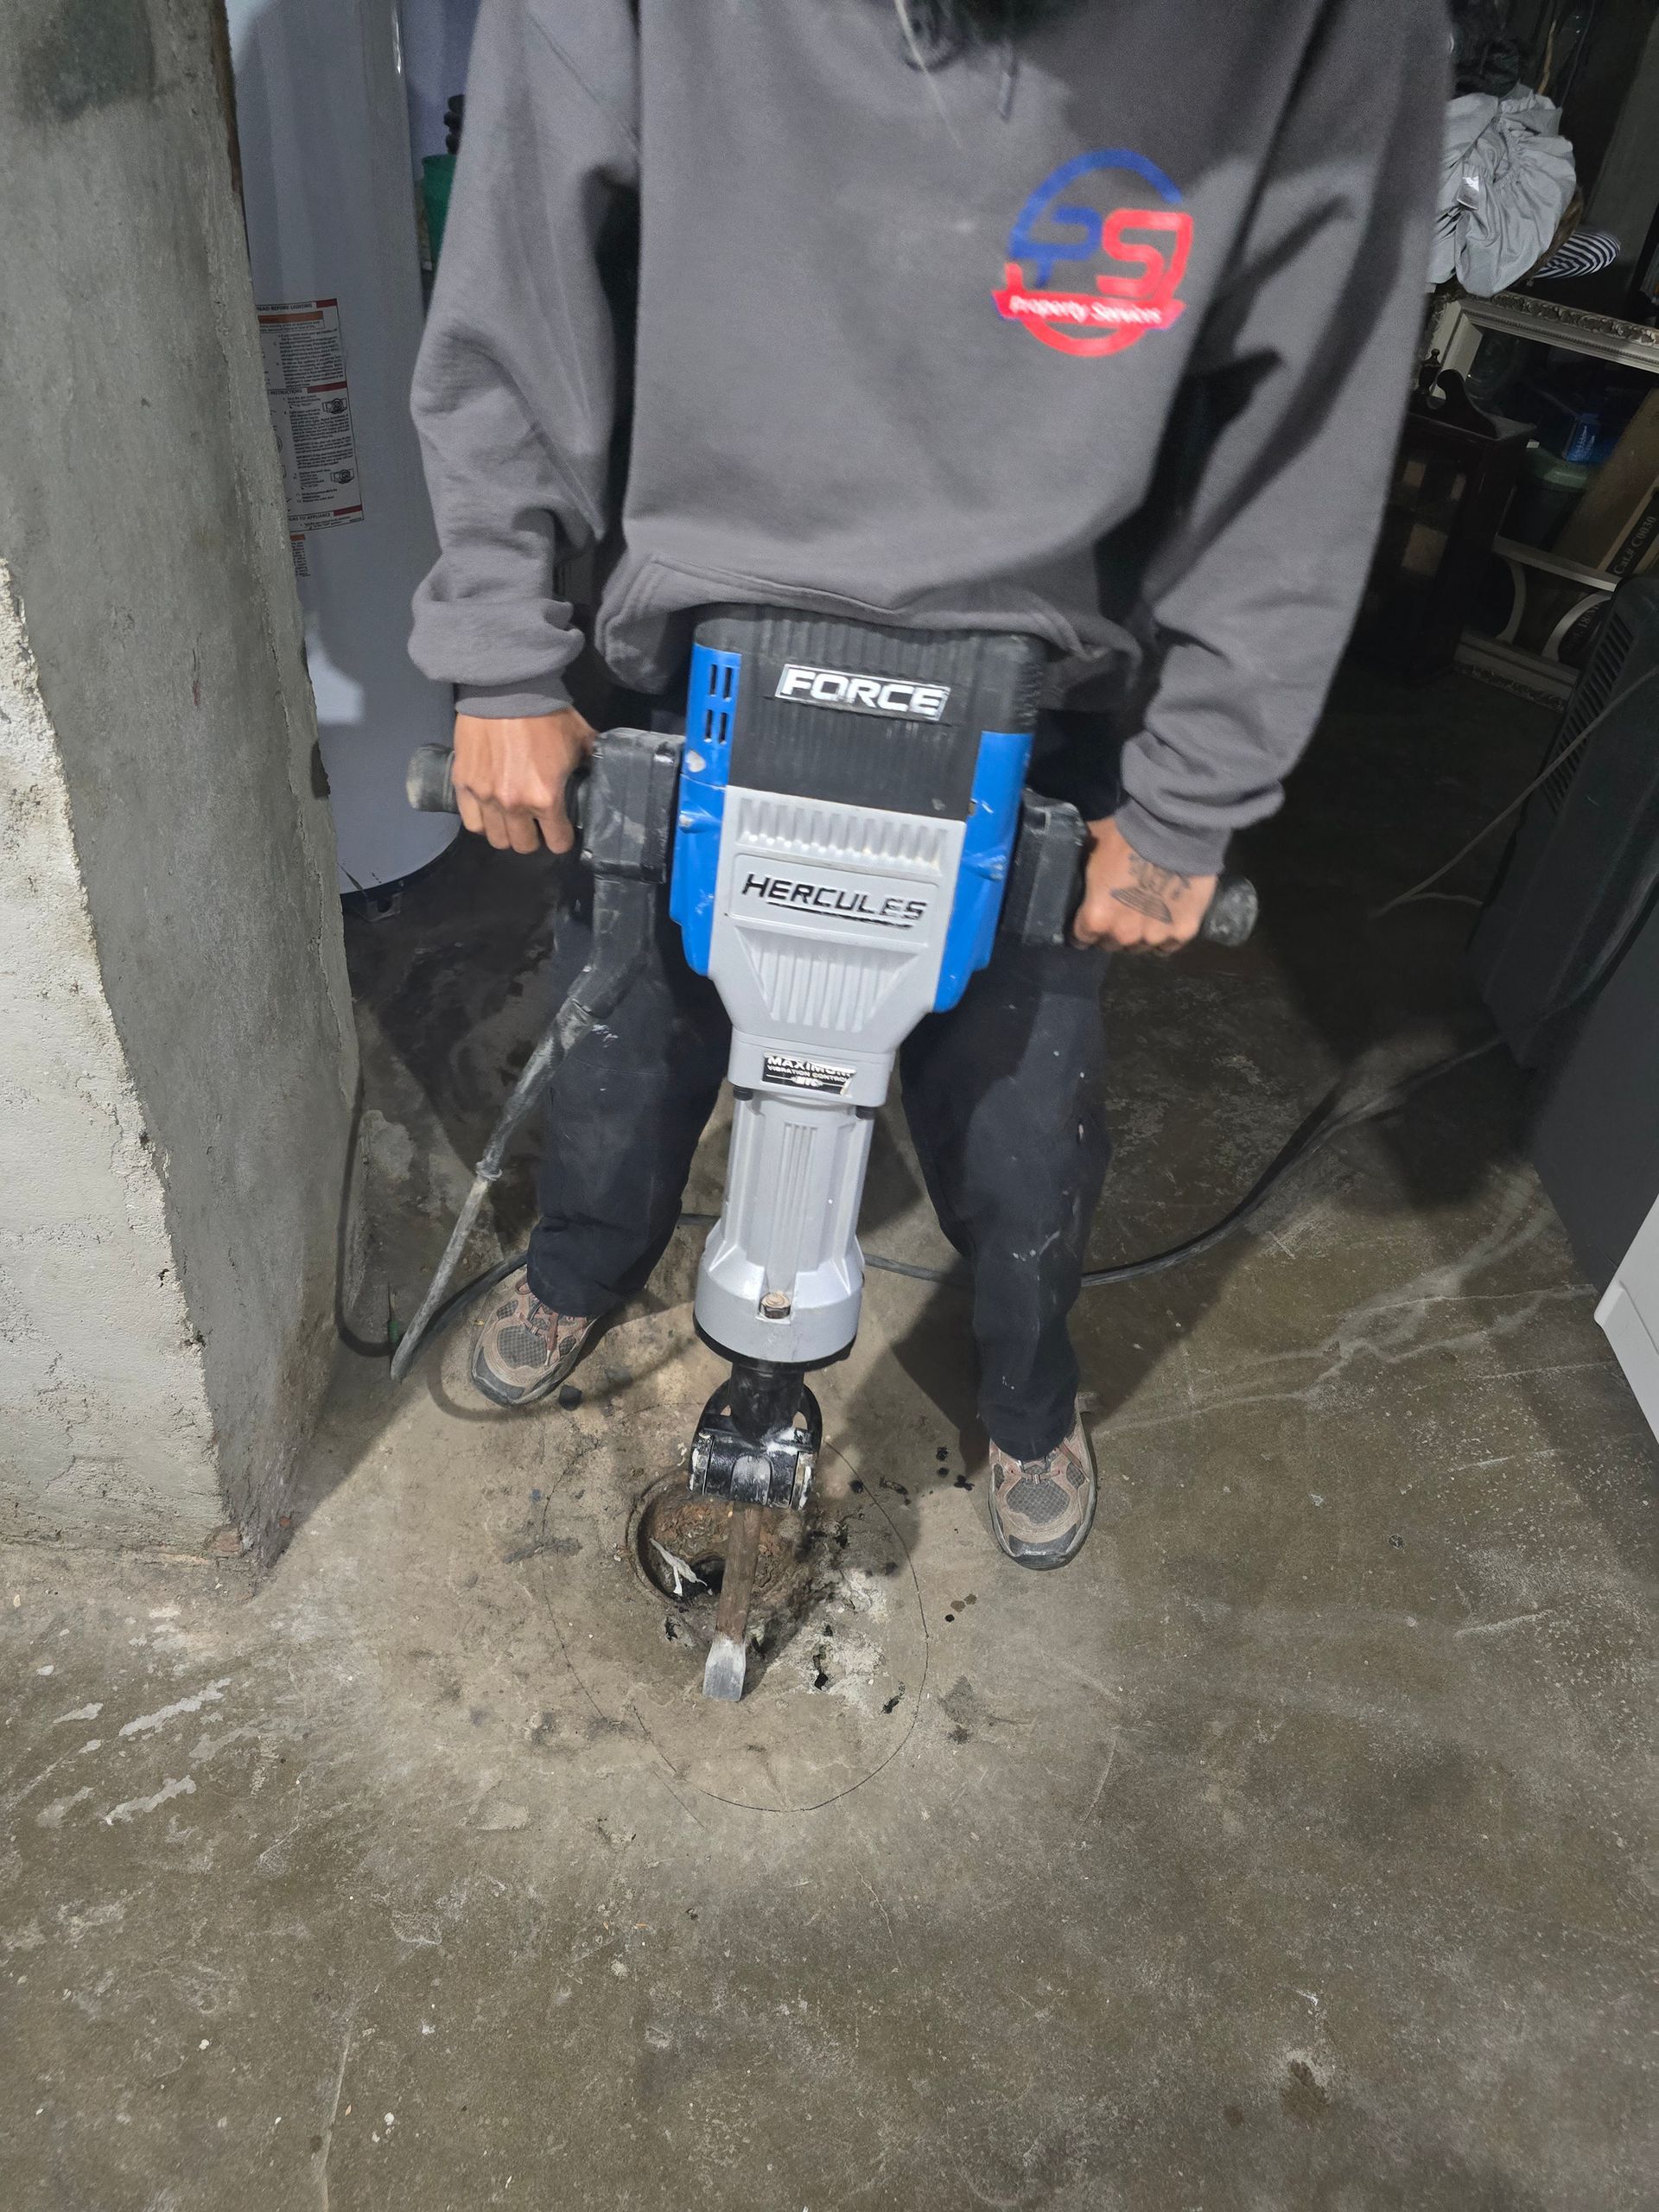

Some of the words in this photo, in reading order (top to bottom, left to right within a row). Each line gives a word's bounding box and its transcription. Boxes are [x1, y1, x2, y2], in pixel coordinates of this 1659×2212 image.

[782, 671, 940, 716] FORCE
[741, 872, 927, 922] HERCULES
[811, 1072, 848, 1083] CONTRO
